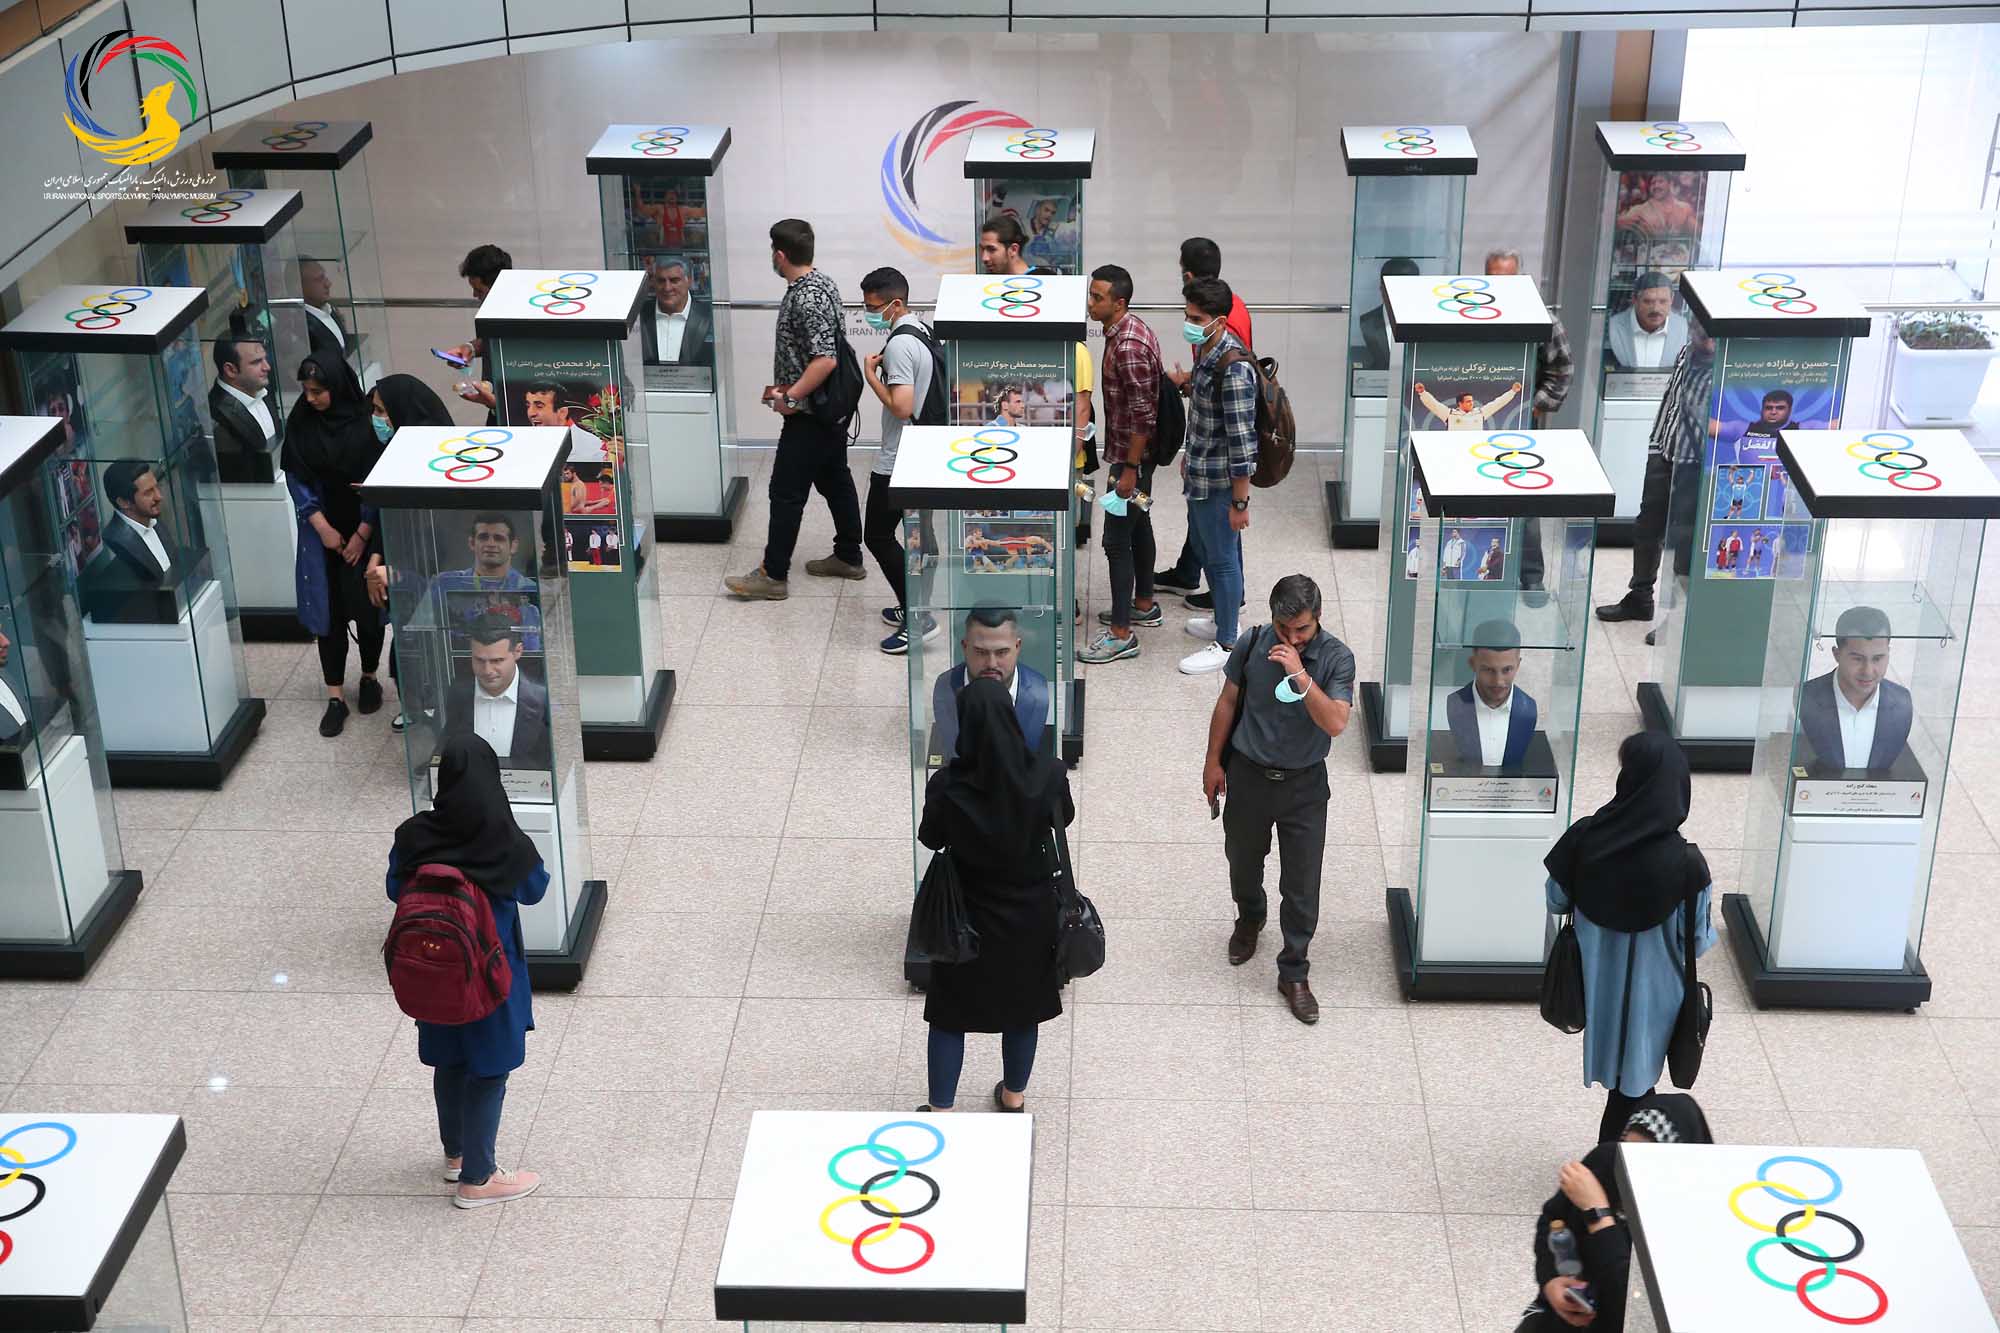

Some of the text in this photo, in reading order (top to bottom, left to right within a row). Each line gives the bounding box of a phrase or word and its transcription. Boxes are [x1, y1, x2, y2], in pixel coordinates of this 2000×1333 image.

[553, 360, 584, 369] محمدی
[585, 360, 601, 370] مراد
[989, 361, 1008, 369] جوکار
[1010, 361, 1037, 369] مصطفی
[1462, 362, 1487, 373] توکلی
[1489, 365, 1516, 373] حسین
[1766, 360, 1798, 370] رضازاده
[1743, 439, 1776, 450] الفضل
